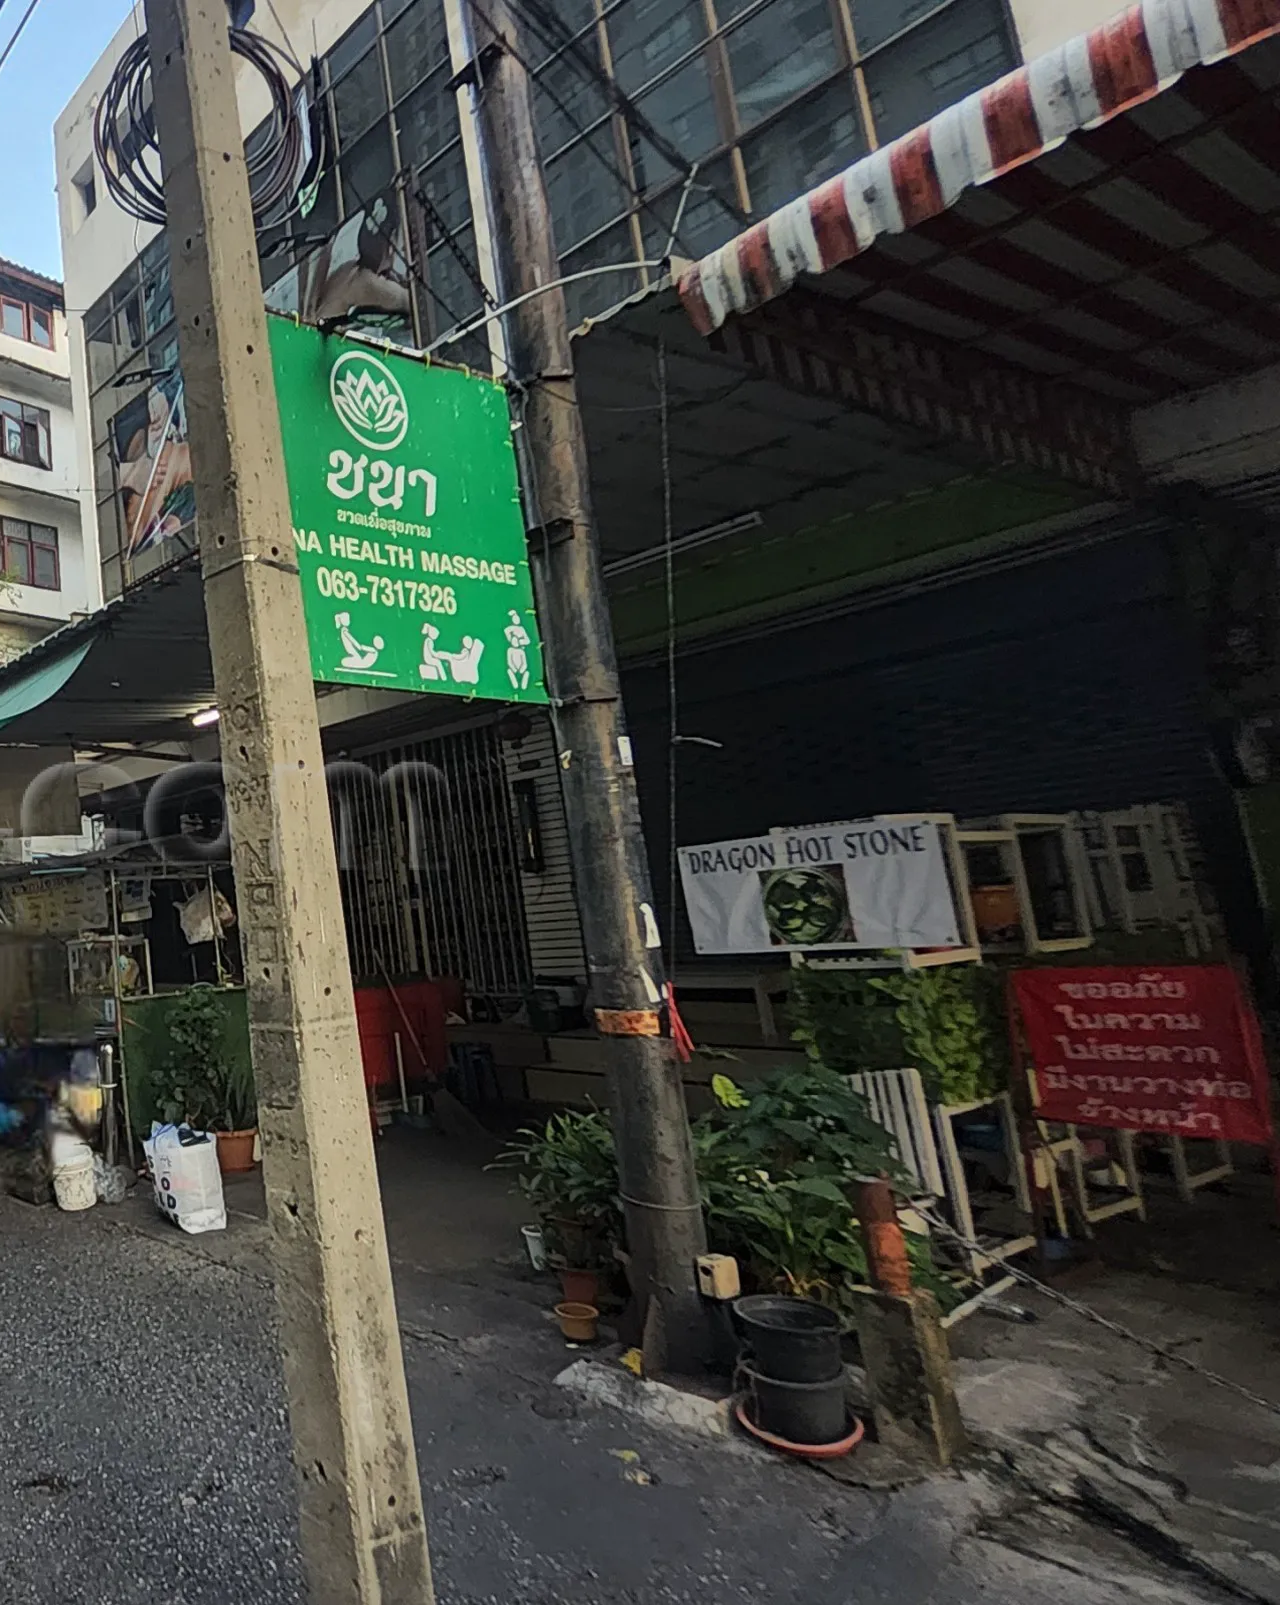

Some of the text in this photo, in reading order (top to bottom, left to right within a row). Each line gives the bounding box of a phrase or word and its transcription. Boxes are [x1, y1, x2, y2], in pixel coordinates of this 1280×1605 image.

[329, 534, 414, 570] HEALTH
[420, 550, 517, 585] MASSAGE
[316, 566, 457, 615] 063-7317326
[688, 825, 926, 875] DRAGON HOT STONE
[1058, 972, 1186, 999] ขออภัย
[1054, 1034, 1221, 1064] ไม่สะดวก
